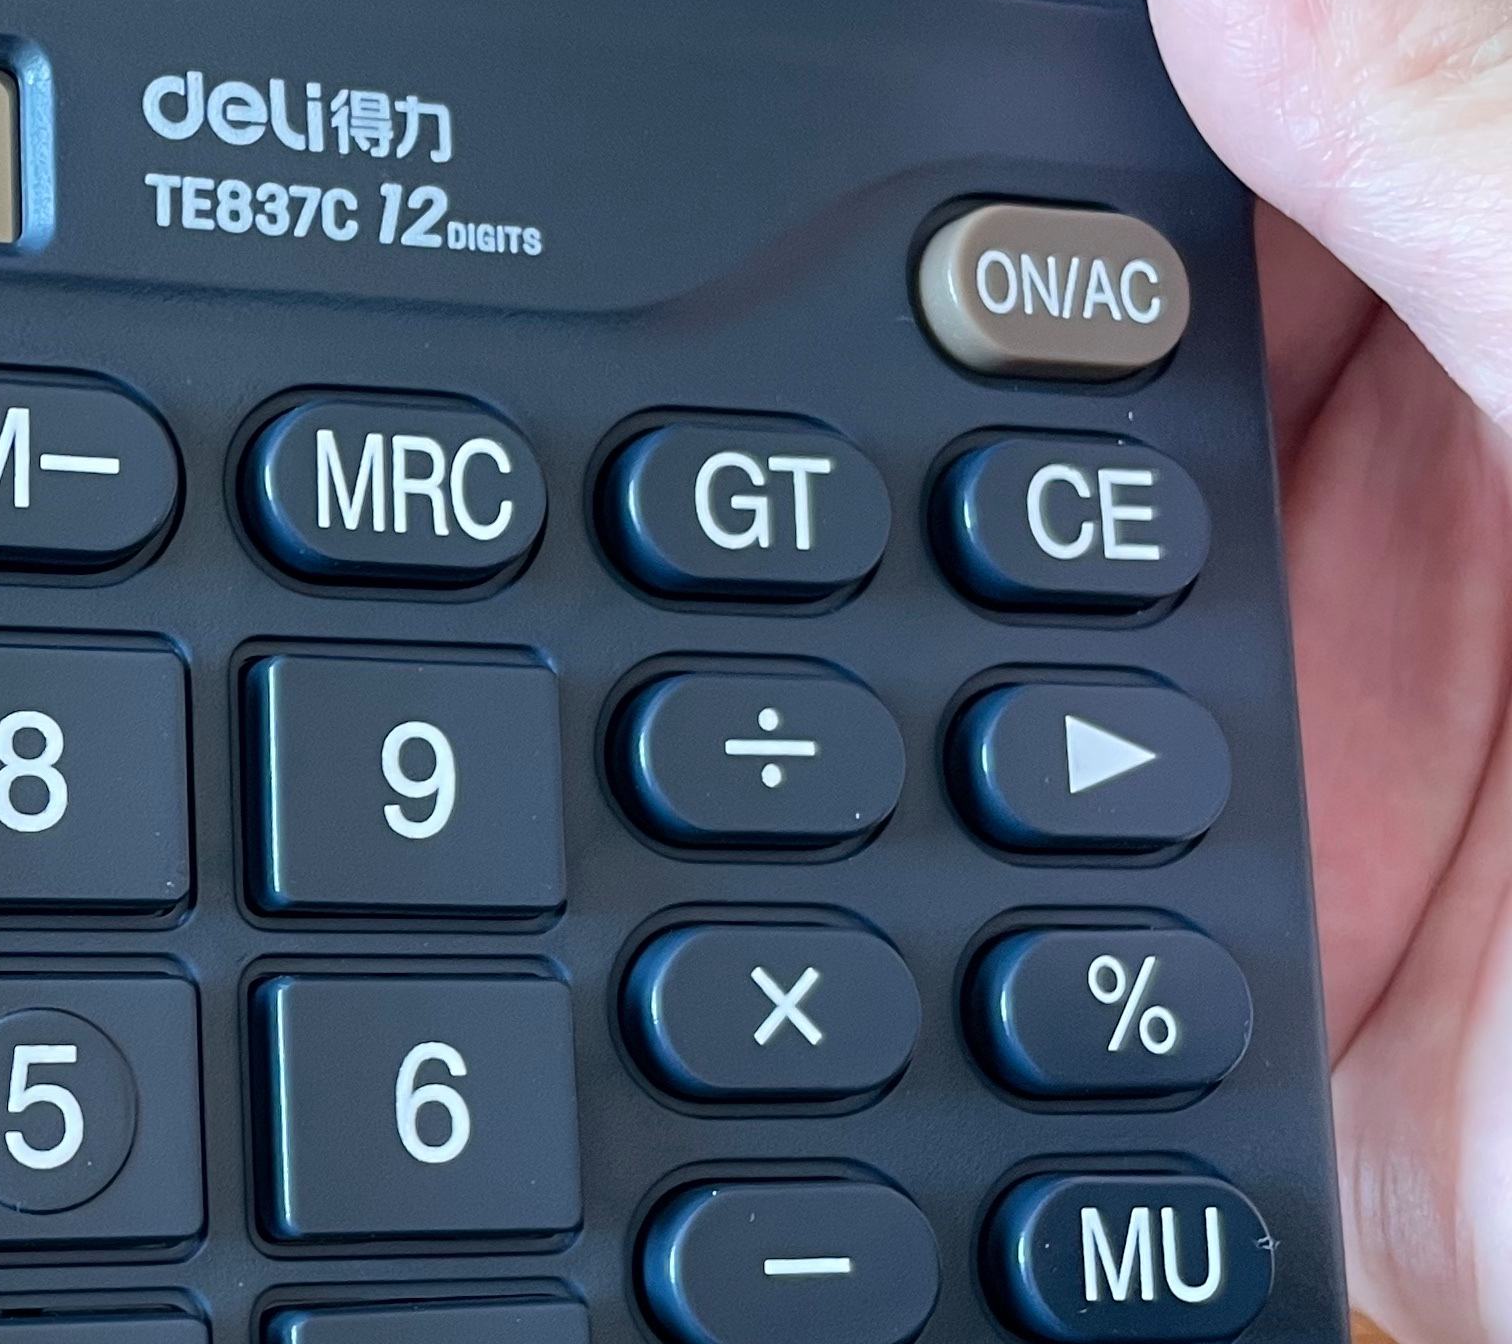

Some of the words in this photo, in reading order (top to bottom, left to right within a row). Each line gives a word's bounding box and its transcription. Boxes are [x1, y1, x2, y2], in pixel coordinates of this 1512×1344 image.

[144, 172, 359, 242] TE837C
[446, 220, 543, 256] DIGITS
[976, 250, 1161, 324] ON/AC
[315, 428, 514, 541] MRC
[694, 451, 832, 551] GT
[1026, 464, 1161, 561] CE
[380, 720, 457, 840] 9
[1087, 954, 1178, 1055] %
[4, 1044, 85, 1170] 5
[395, 1040, 471, 1164] 6
[1080, 1206, 1222, 1304] MU
